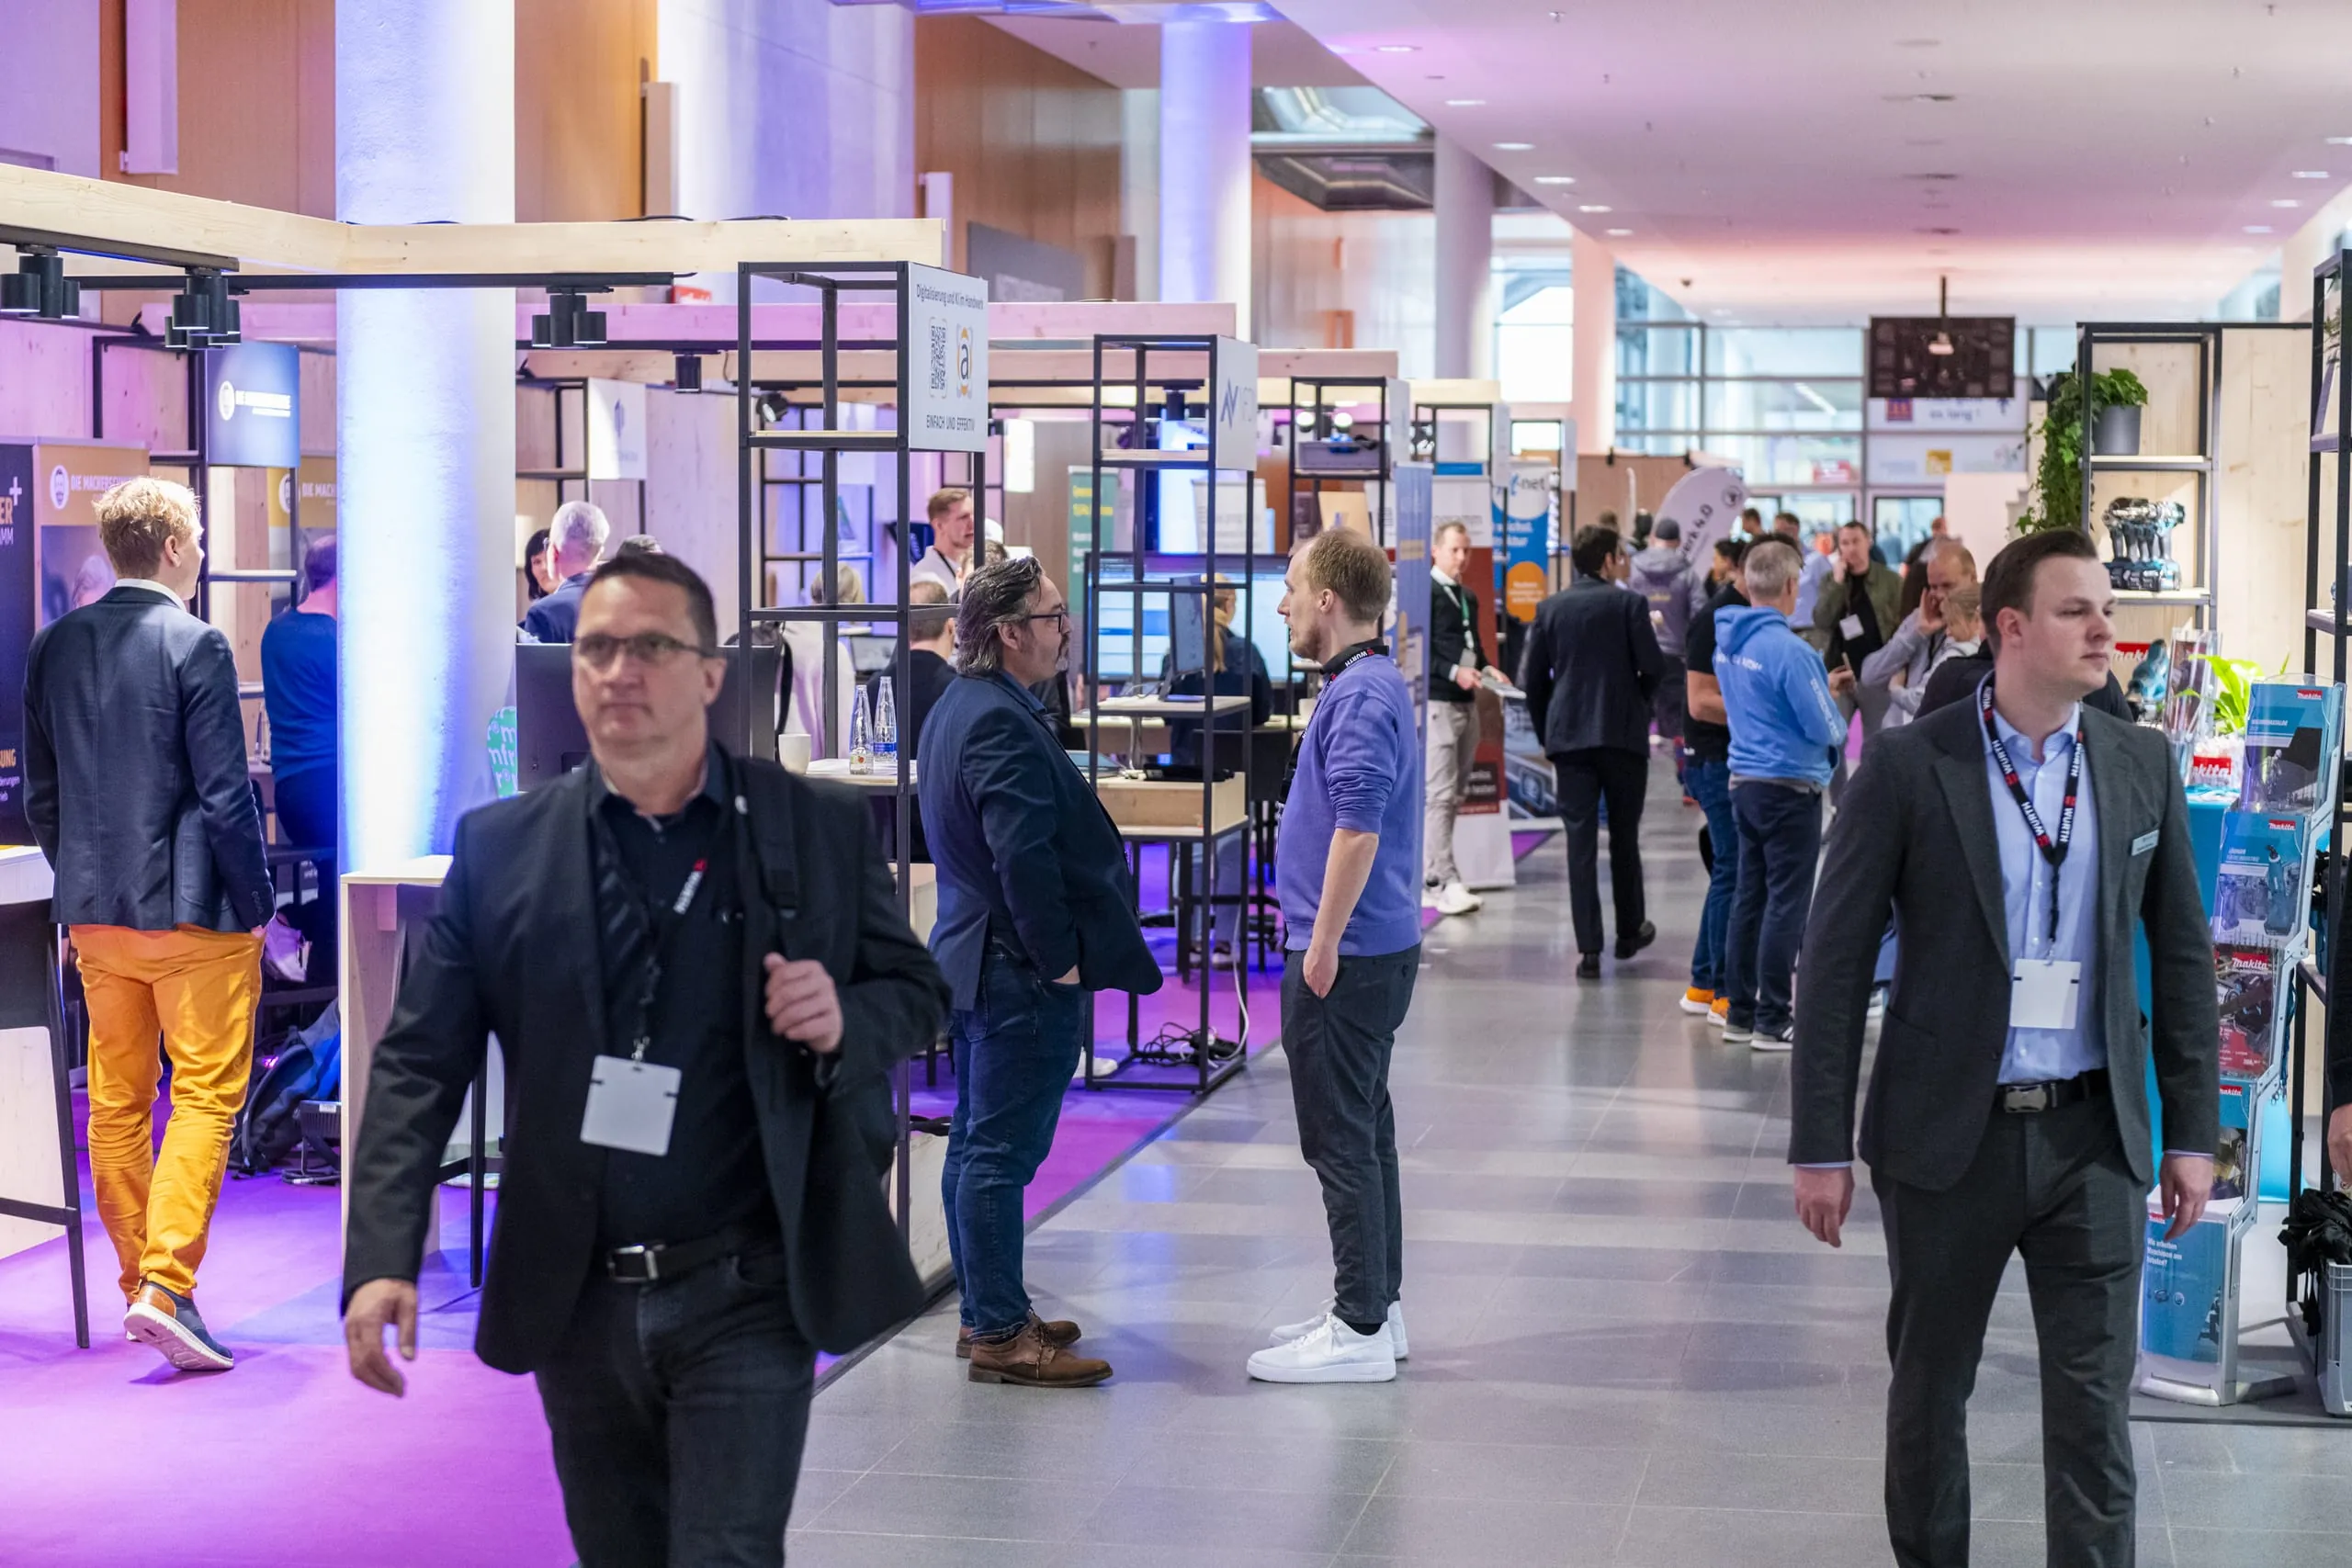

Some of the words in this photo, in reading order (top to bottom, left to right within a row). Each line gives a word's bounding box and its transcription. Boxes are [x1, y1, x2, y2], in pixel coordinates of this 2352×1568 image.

[926, 414, 945, 430] EINFACH
[945, 415, 956, 431] UND
[956, 416, 976, 432] EFFEKTIV
[2232, 957, 2268, 971] makita
